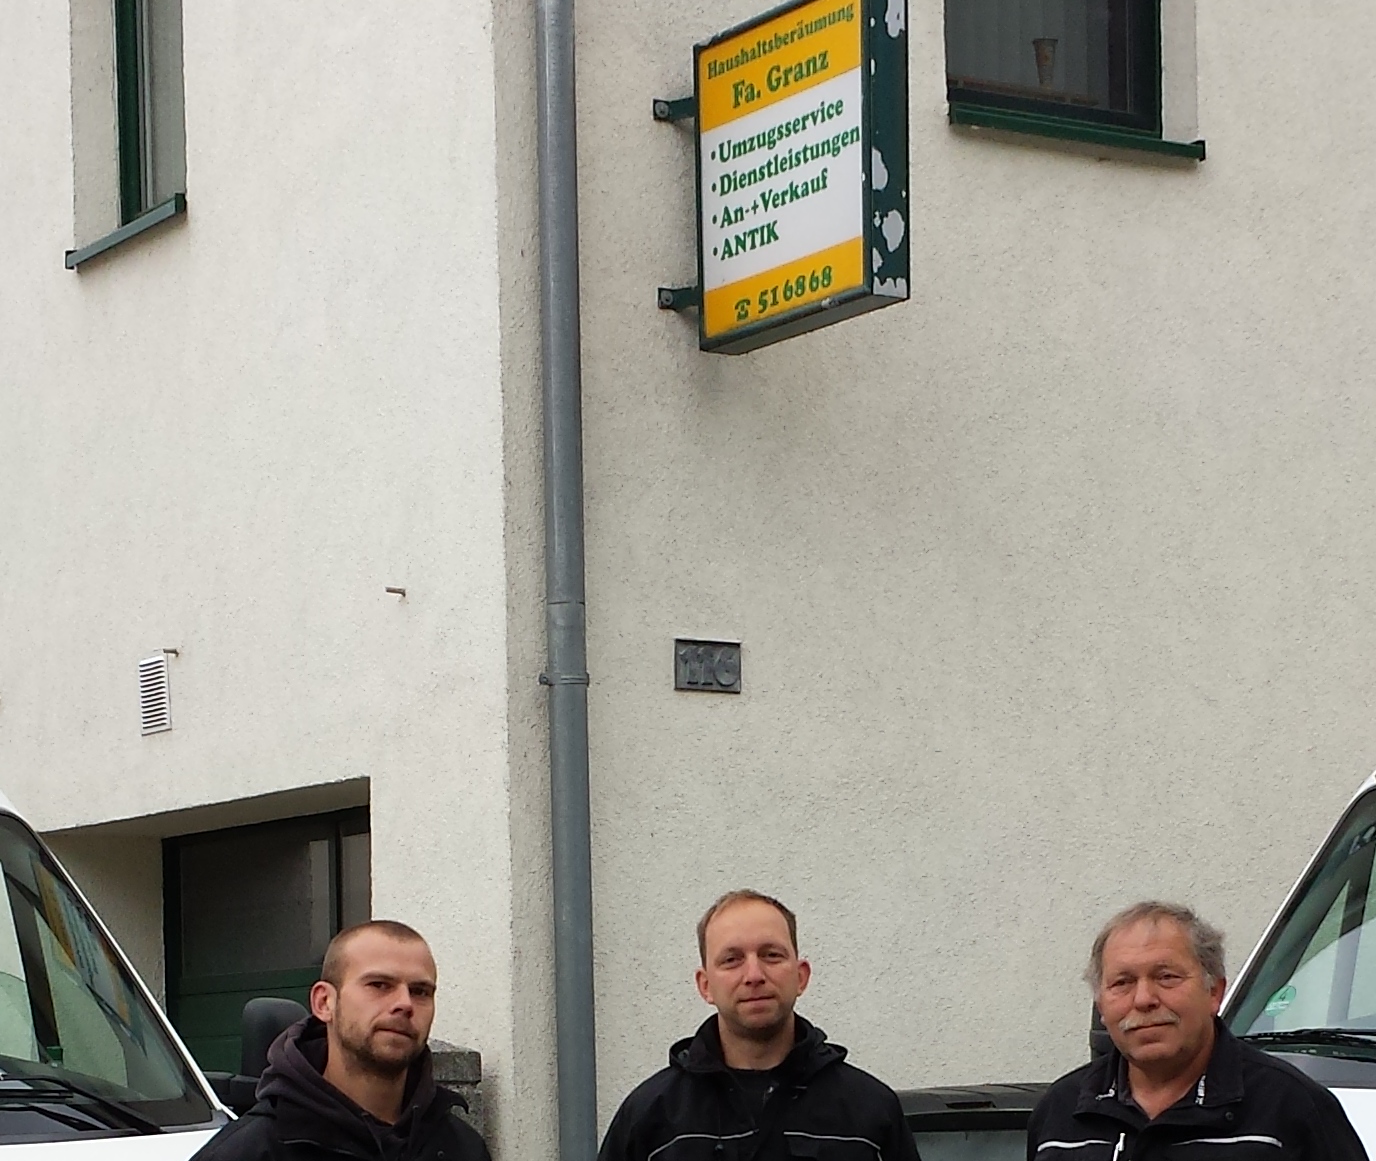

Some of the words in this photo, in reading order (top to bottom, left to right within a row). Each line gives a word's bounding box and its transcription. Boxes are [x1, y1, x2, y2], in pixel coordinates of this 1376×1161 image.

[708, 3, 854, 79] Haushaltsberäumung
[732, 79, 761, 109] Fa.
[766, 50, 829, 93] Granz
[718, 99, 844, 163] Umzugsservice
[719, 125, 860, 197] Dienstleistungen
[720, 220, 780, 261] ANTIK
